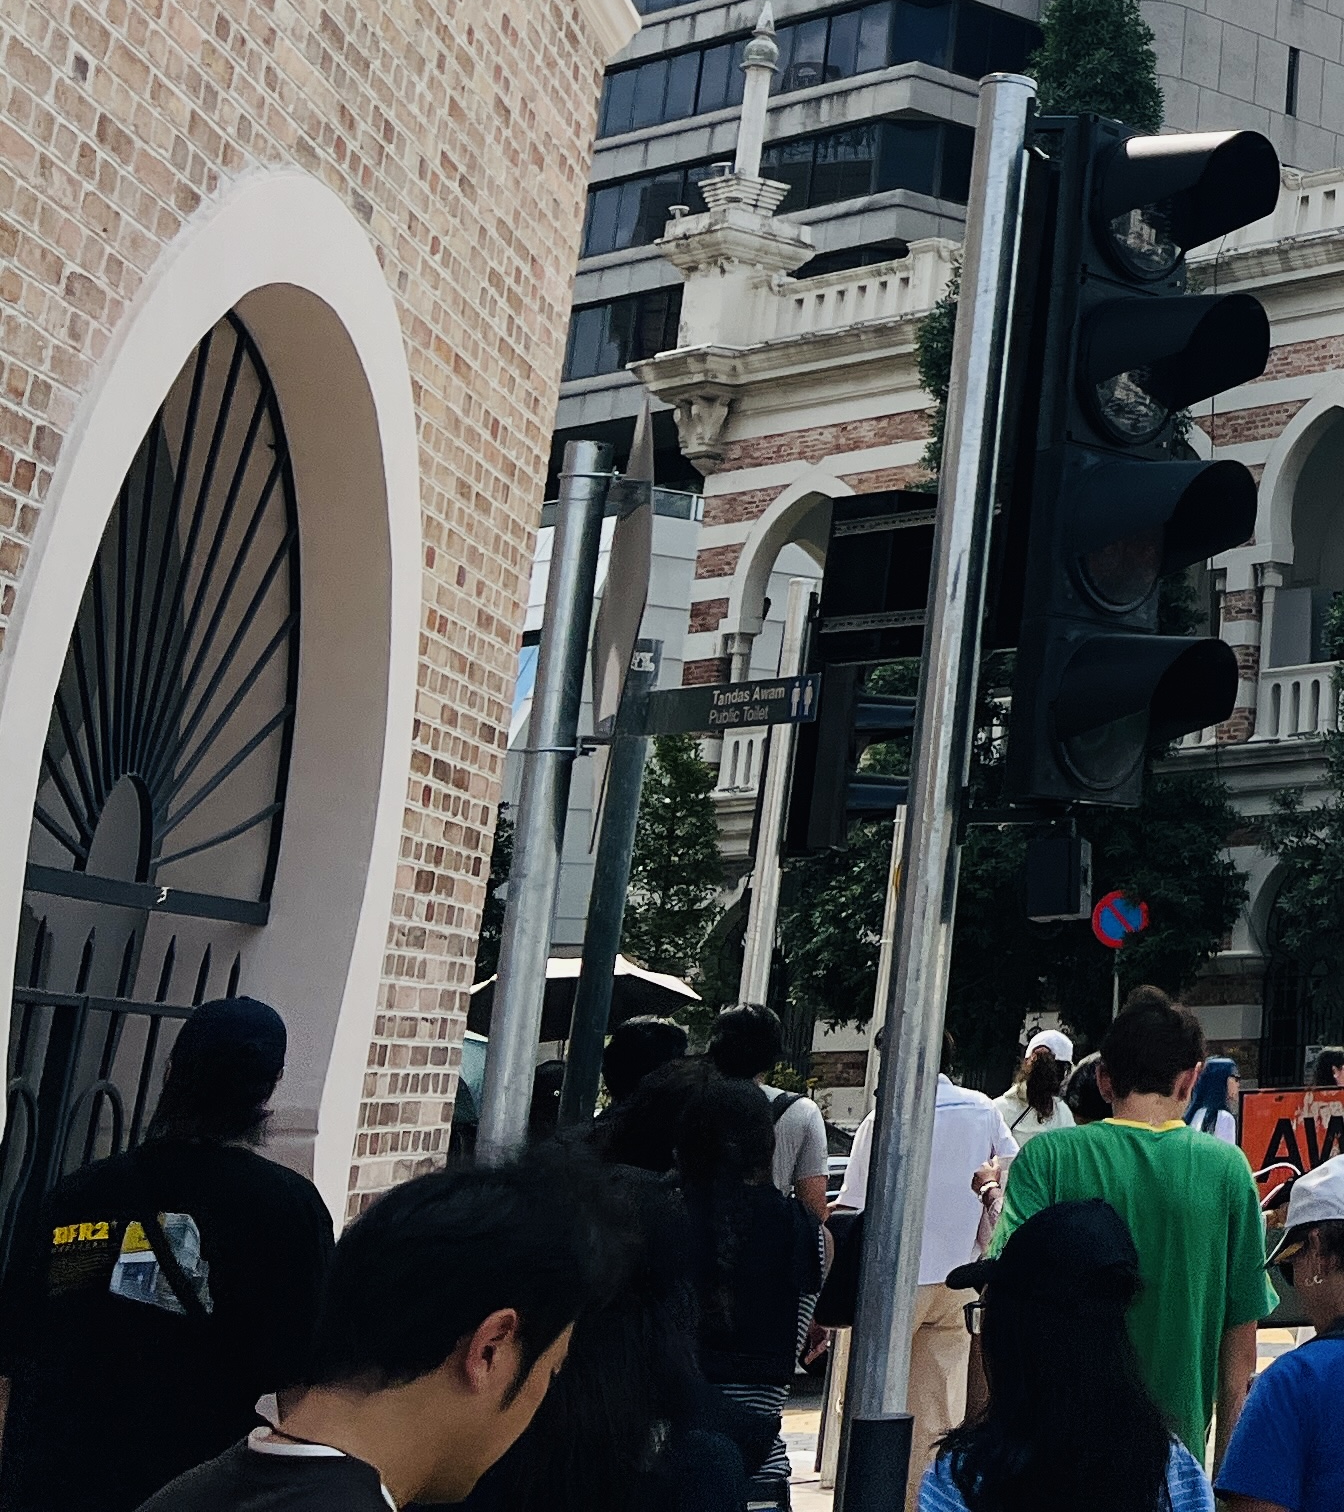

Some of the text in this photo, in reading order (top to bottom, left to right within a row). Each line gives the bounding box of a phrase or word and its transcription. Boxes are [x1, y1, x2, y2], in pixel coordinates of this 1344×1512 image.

[712, 686, 785, 706] Tandas Awam
[708, 705, 769, 725] Public Toilet
